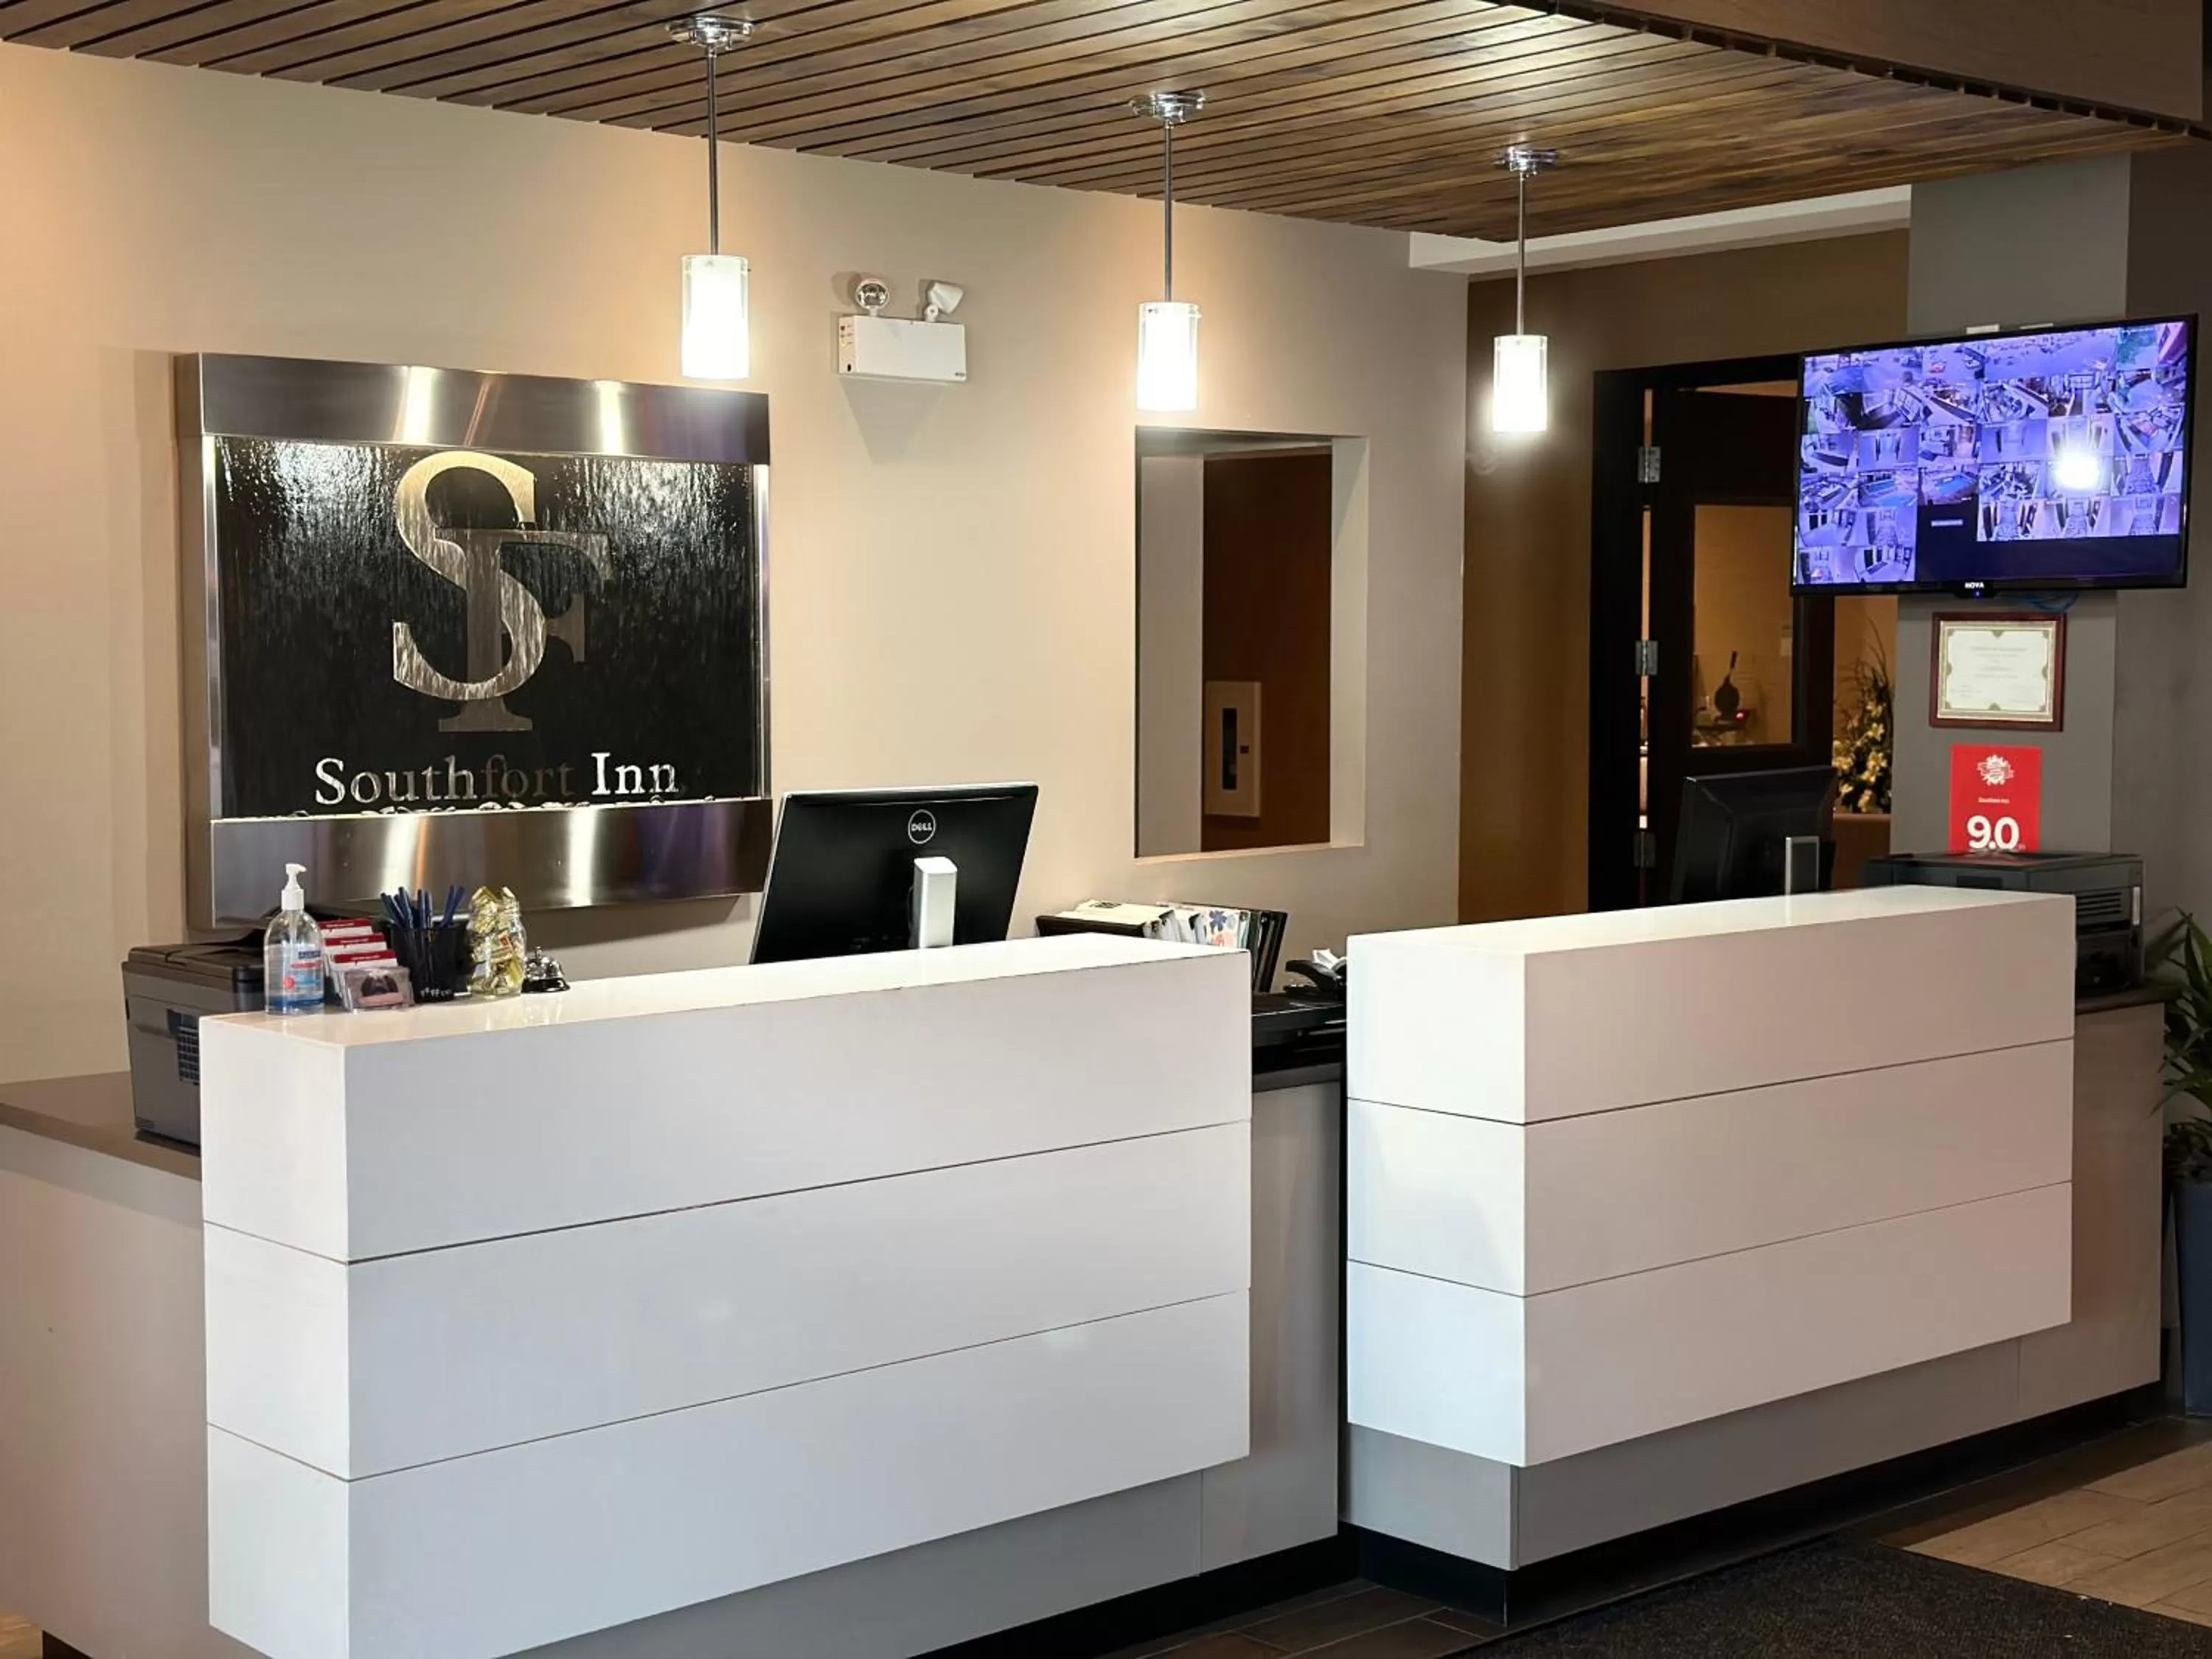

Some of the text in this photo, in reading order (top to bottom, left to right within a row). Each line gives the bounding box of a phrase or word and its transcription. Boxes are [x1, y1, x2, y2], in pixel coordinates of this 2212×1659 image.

[314, 751, 679, 805] Southfort Inn
[911, 822, 933, 832] DELL
[1966, 815, 2020, 850] 9.0
